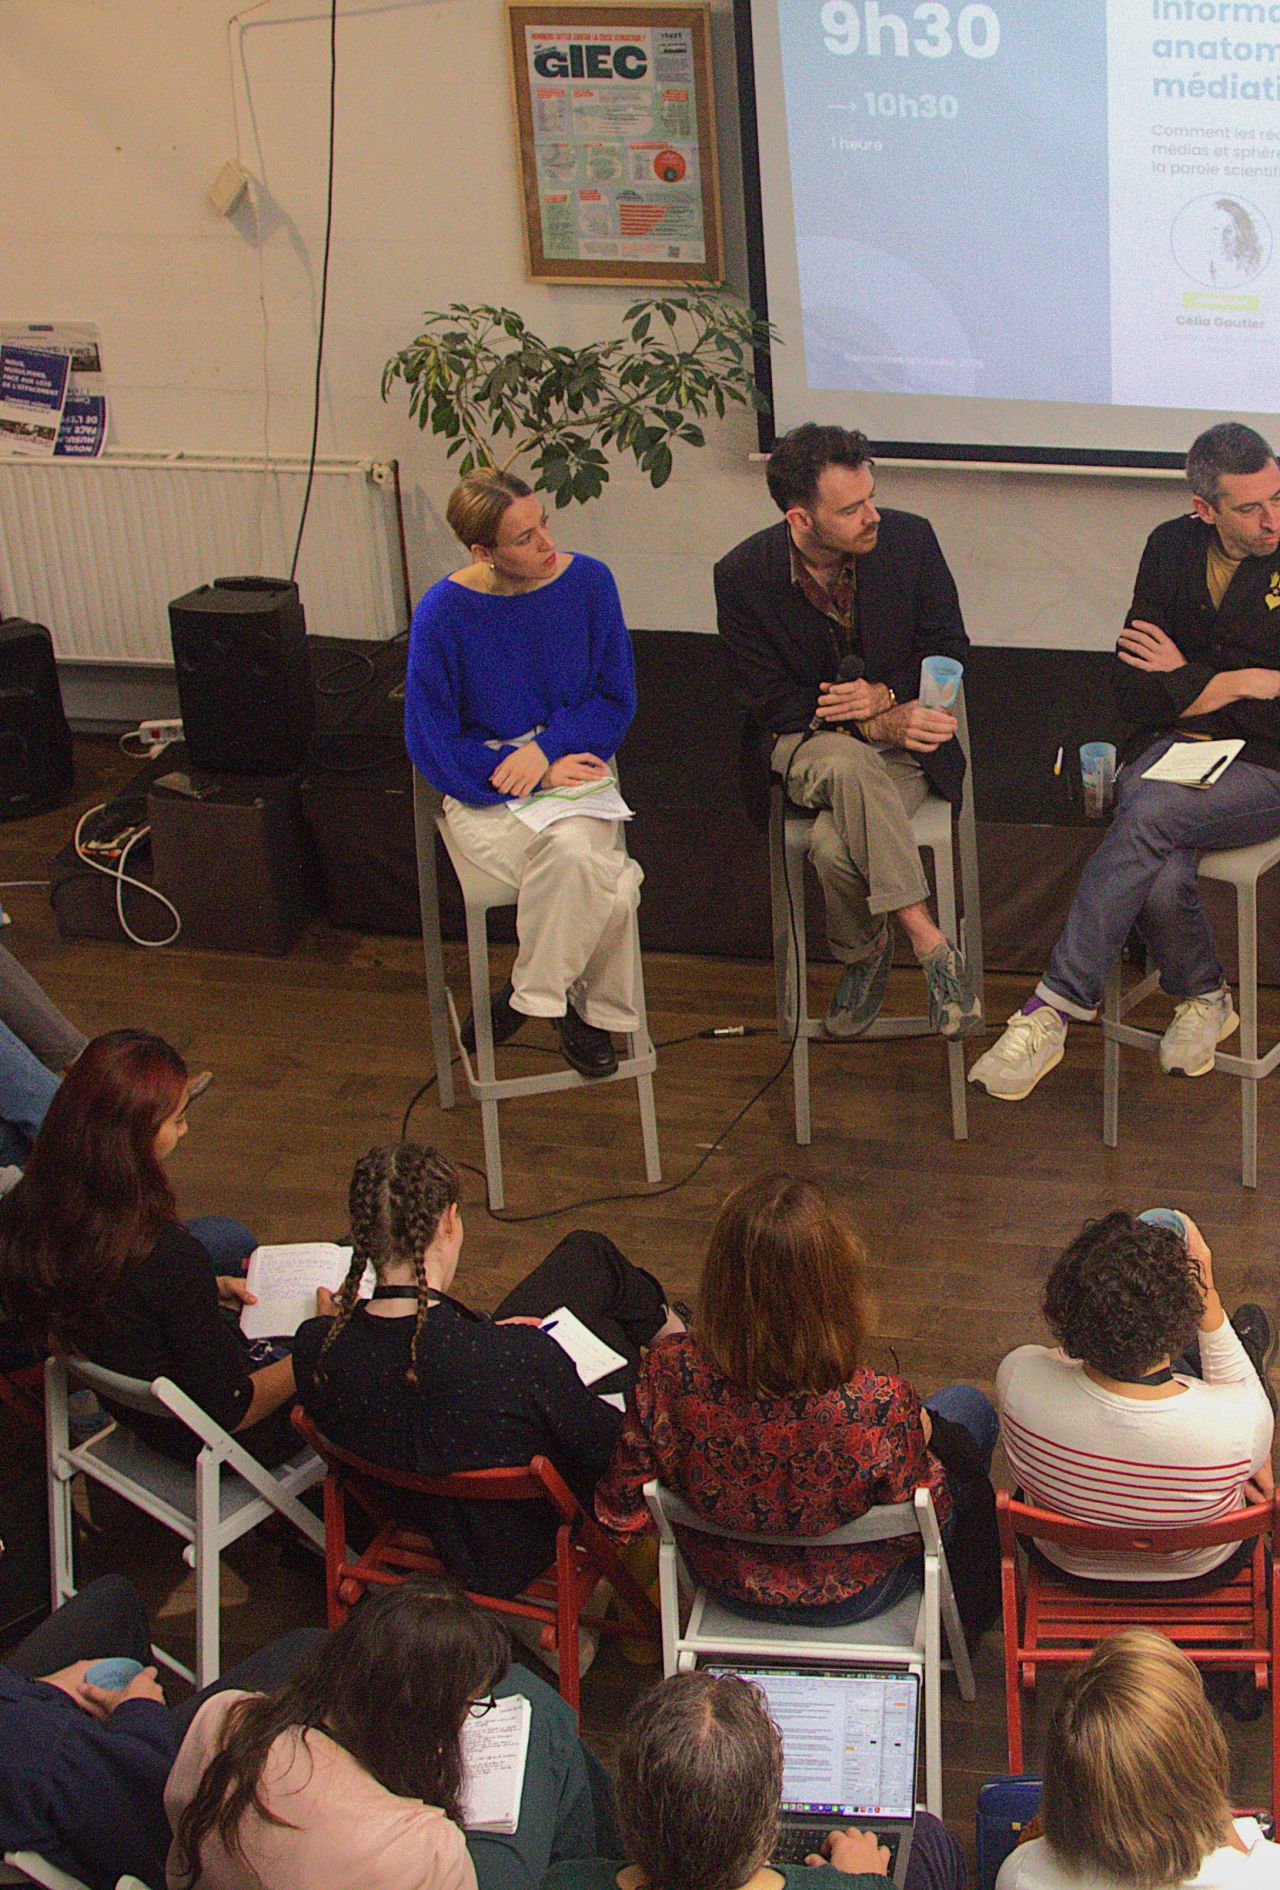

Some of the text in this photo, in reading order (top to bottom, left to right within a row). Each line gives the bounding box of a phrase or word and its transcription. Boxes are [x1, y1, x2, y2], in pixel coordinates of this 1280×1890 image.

[820, 0, 1000, 59] 9h30
[534, 44, 648, 80] GIEC
[864, 92, 958, 119] 10h30
[1152, 124, 1230, 139] Comment
[1234, 127, 1256, 141] les
[839, 137, 883, 150] heure
[1152, 143, 1209, 157] médias
[1213, 145, 1229, 158] et
[1152, 160, 1166, 173] la
[1170, 161, 1220, 178] parole
[1213, 317, 1266, 329] Gautier
